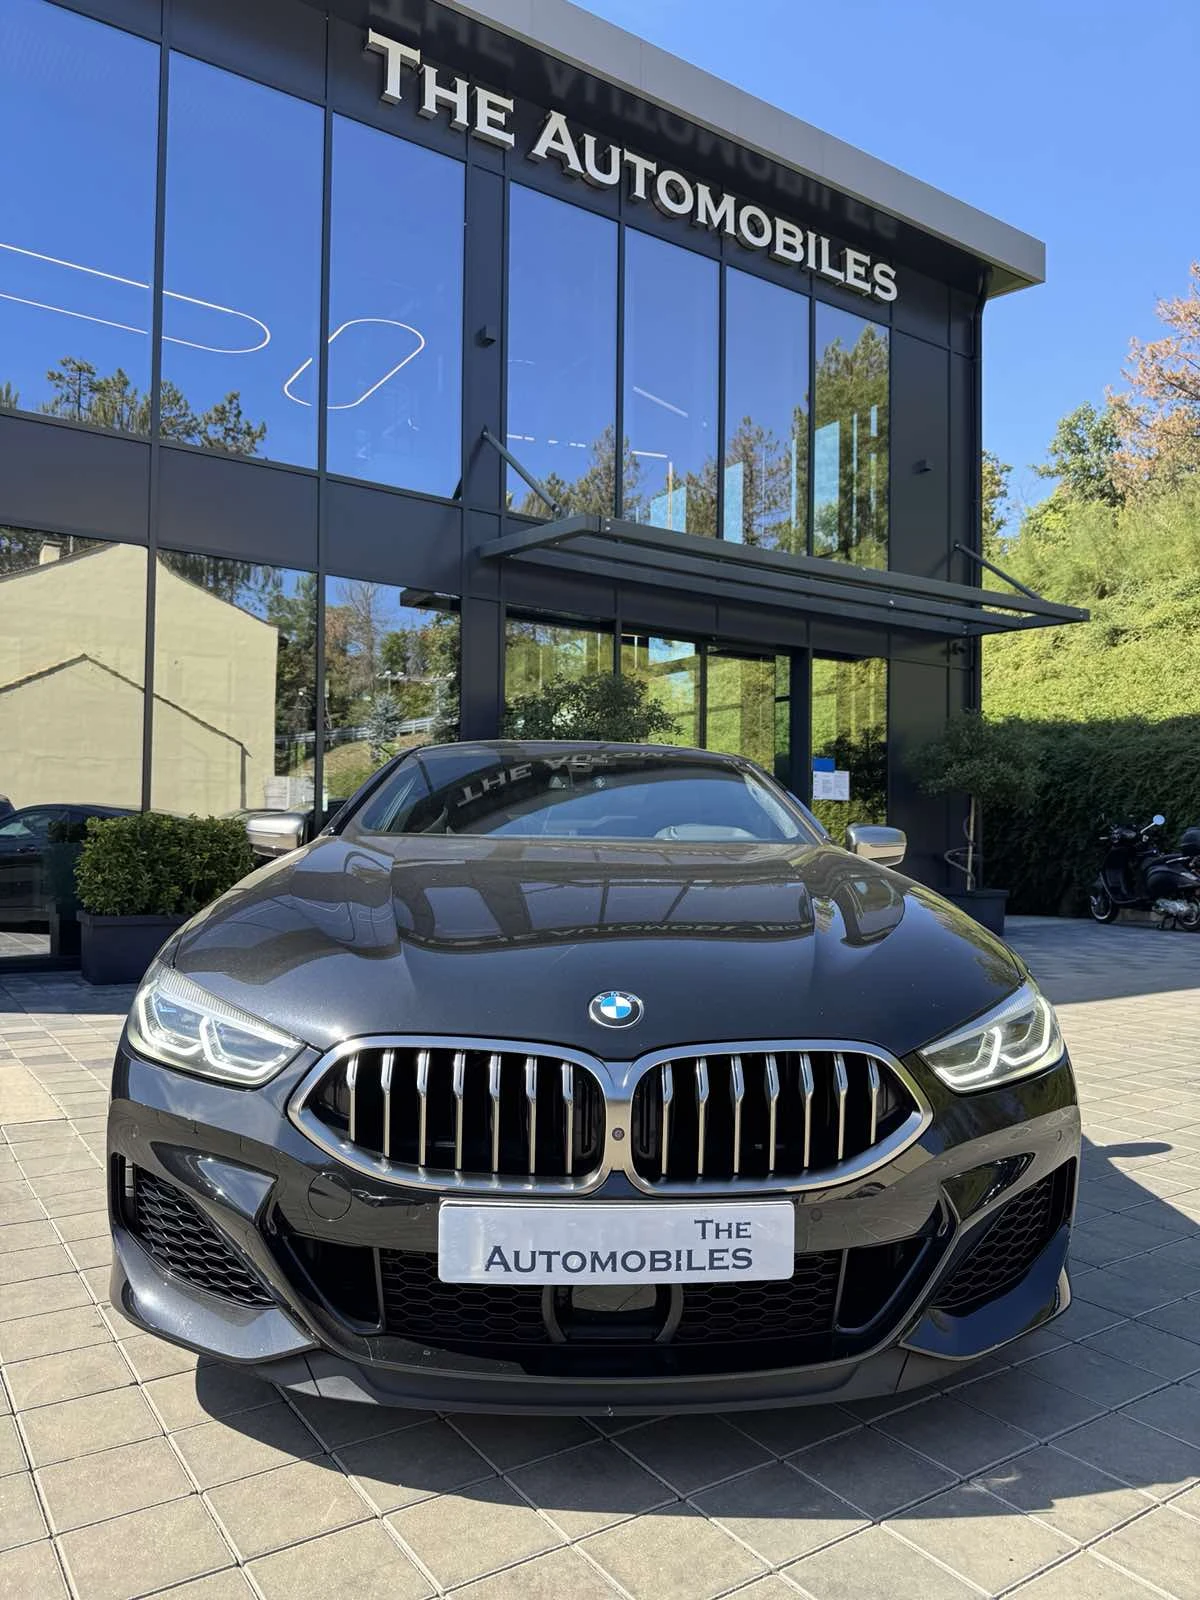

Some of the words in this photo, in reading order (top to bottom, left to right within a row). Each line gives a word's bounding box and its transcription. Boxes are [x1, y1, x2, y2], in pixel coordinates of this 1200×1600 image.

[366, 28, 515, 150] THE
[527, 110, 899, 302] AUTOMOBILES
[694, 1219, 752, 1240] THE
[484, 1245, 753, 1274] AUTOMOBILES
